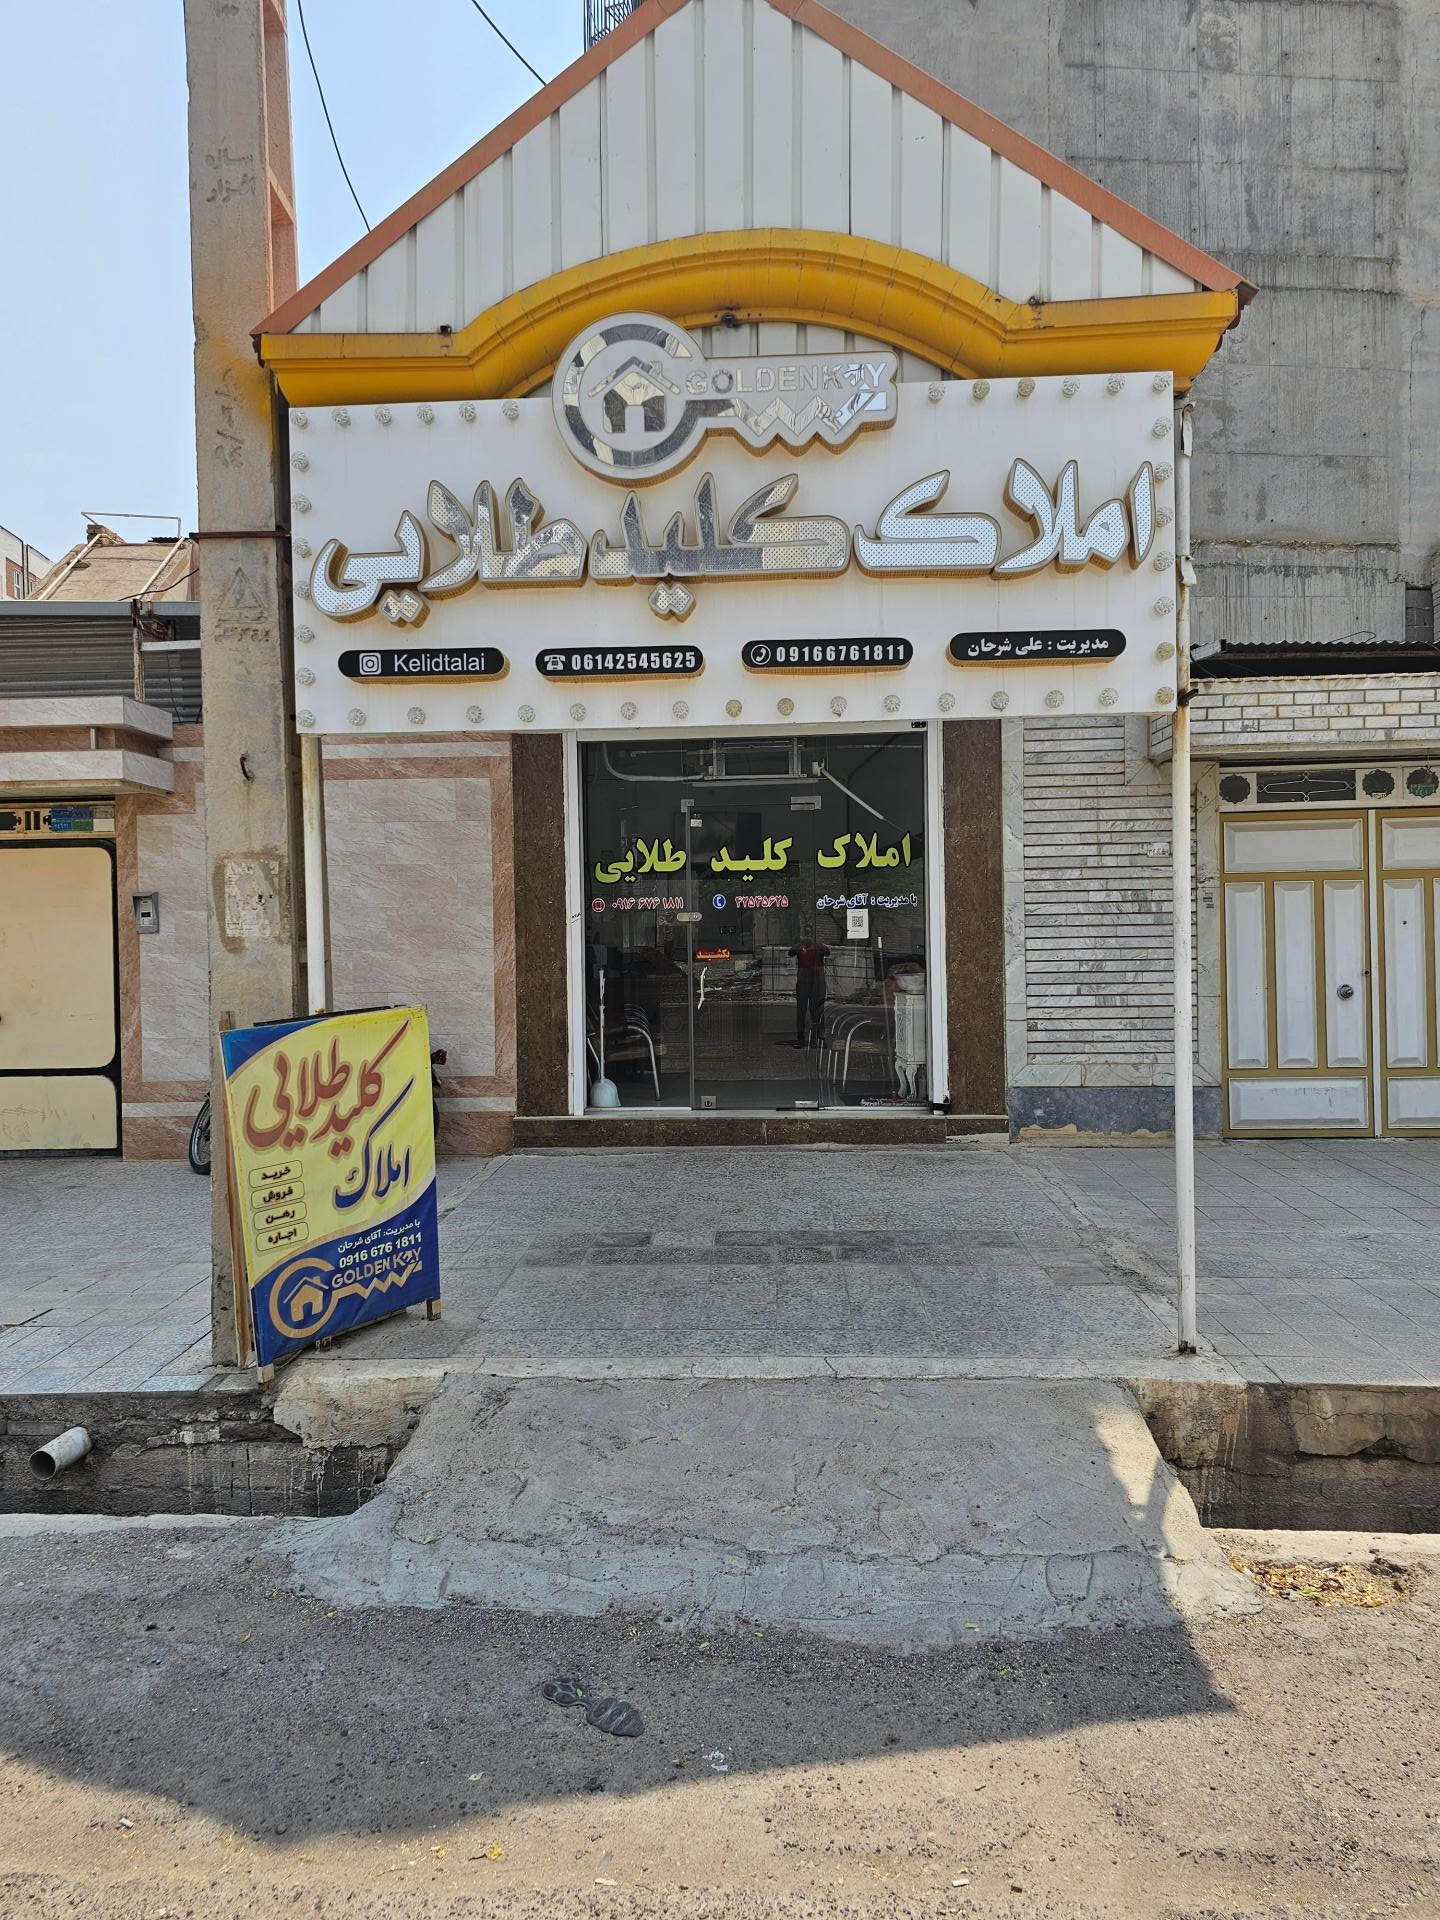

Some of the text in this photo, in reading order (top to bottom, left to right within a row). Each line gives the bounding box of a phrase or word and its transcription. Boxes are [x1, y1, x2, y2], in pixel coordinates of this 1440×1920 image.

[309, 458, 1156, 624] املاک کلید طلایی
[776, 644, 905, 663] 09166761811
[967, 638, 1012, 658] شرحان
[1014, 636, 1043, 656] علی
[1056, 636, 1110, 655] مدیریت
[394, 653, 486, 673] Kelidtalai
[571, 652, 696, 671] 06142545625
[594, 832, 912, 884] املاک کلید طلایی
[816, 894, 846, 910] شرحان
[846, 893, 869, 910] آقای
[877, 894, 909, 909] مدیریت
[910, 893, 918, 907] با
[244, 1019, 410, 1157] کلید طلایی
[333, 1077, 415, 1208] املاک
[261, 1166, 291, 1181] خرید
[263, 1186, 293, 1203] فروش
[265, 1209, 295, 1224] رهن
[414, 1219, 421, 1229] با
[268, 1228, 297, 1244] اجاره
[337, 1236, 364, 1253] شرحان
[364, 1229, 382, 1245] آقای
[339, 1231, 422, 1269] 0916 676 1811
[331, 1256, 391, 1288] GOLDEN
